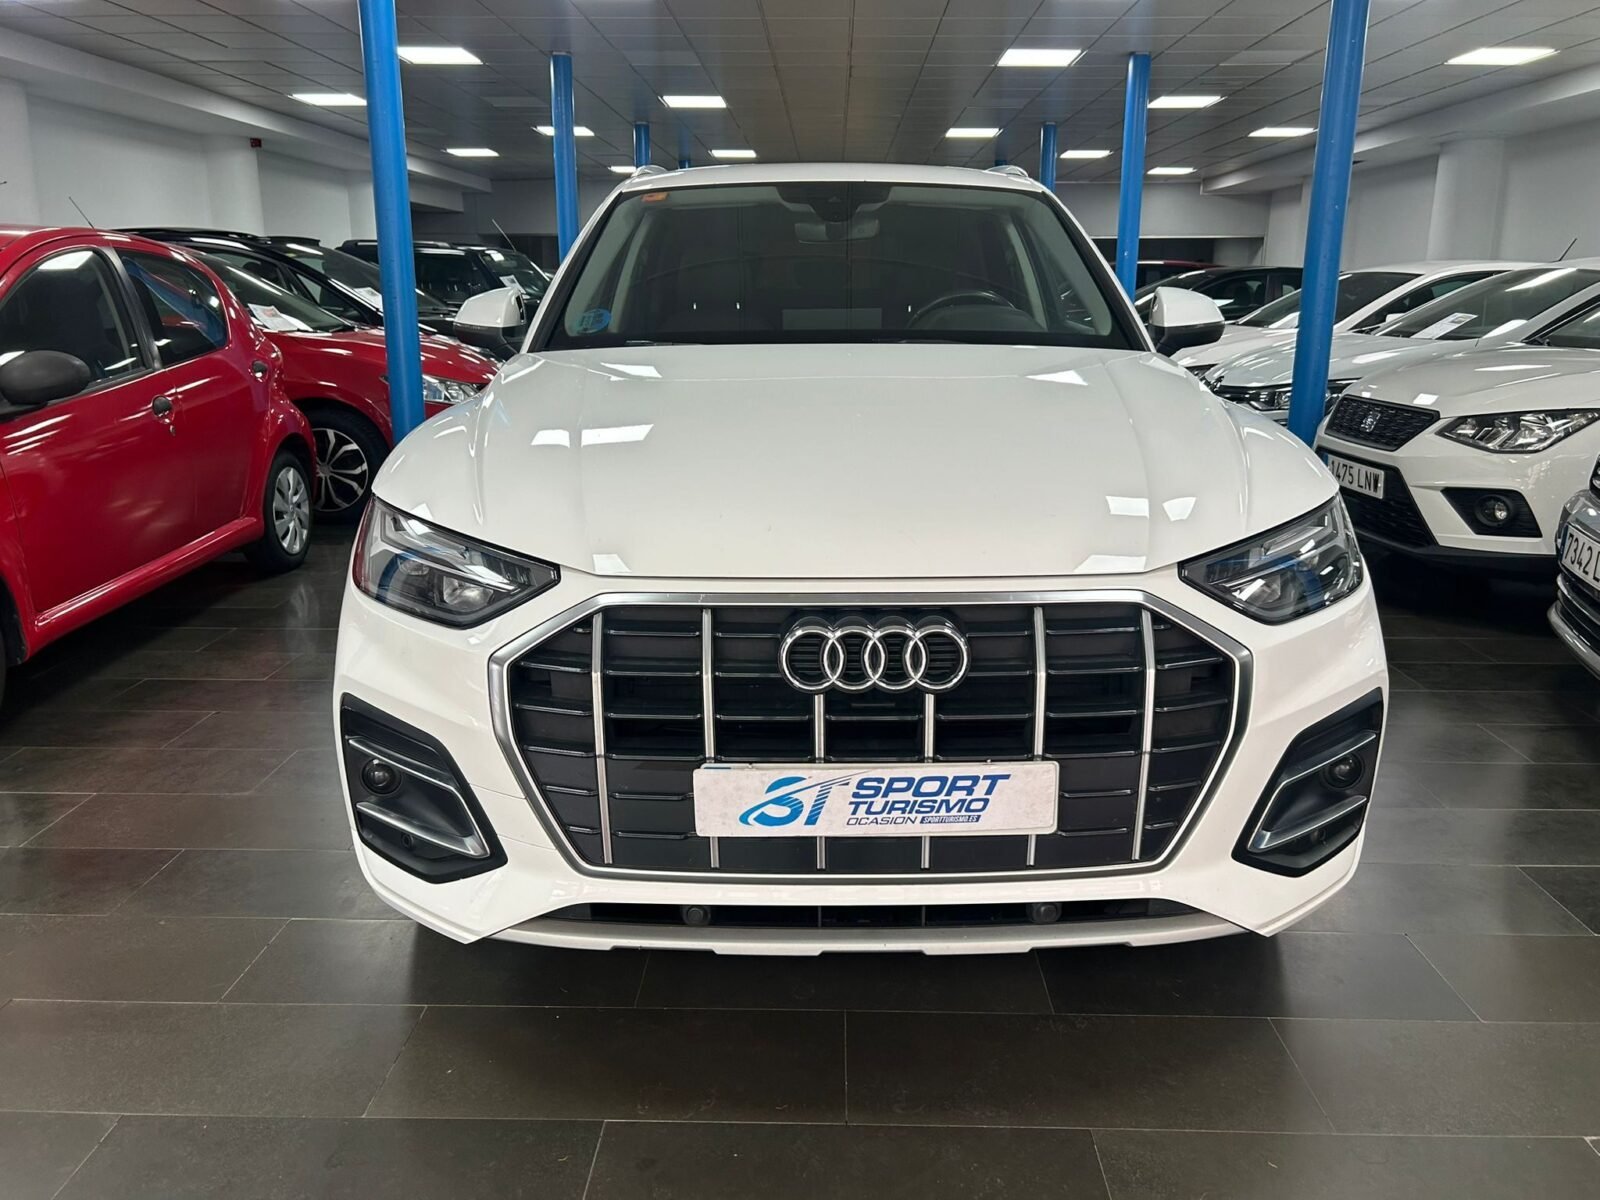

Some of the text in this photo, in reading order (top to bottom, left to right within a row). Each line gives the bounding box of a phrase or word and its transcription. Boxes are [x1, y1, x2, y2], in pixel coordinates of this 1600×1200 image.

[1357, 468, 1379, 493] LNW
[1565, 532, 1593, 576] 7342
[851, 774, 1011, 798] SPORT
[848, 798, 990, 815] TURISMO
[846, 816, 918, 826] OCASION
